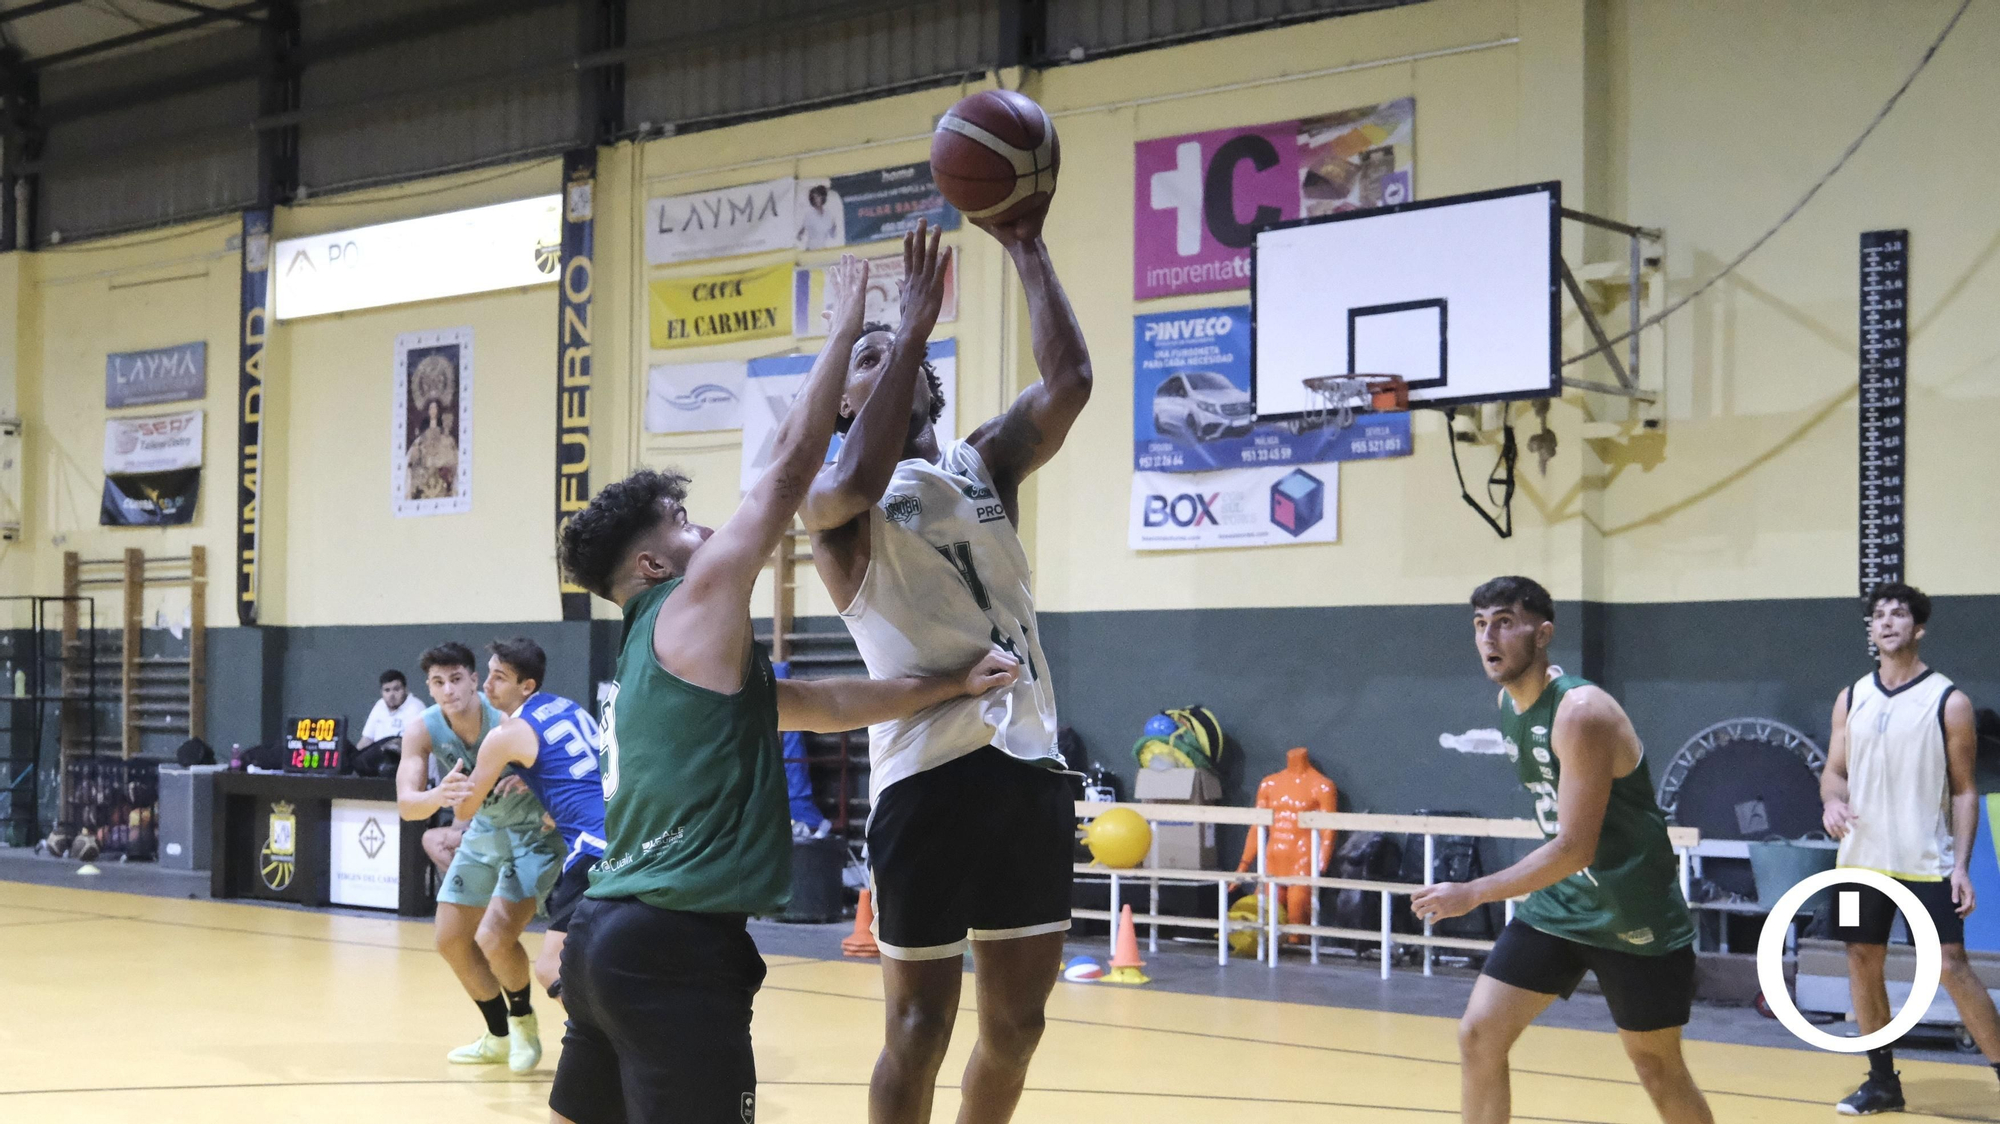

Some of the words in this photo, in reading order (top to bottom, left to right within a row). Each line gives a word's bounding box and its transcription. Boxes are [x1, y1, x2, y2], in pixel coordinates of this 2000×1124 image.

[659, 191, 778, 234] LAYMA
[667, 318, 690, 340] EL
[694, 307, 778, 337] CARMEN
[1144, 315, 1233, 342] PINVECO
[115, 351, 196, 384] LAYMA
[1143, 491, 1220, 528] BOX
[296, 718, 335, 741] 10:00
[543, 706, 601, 780] 34
